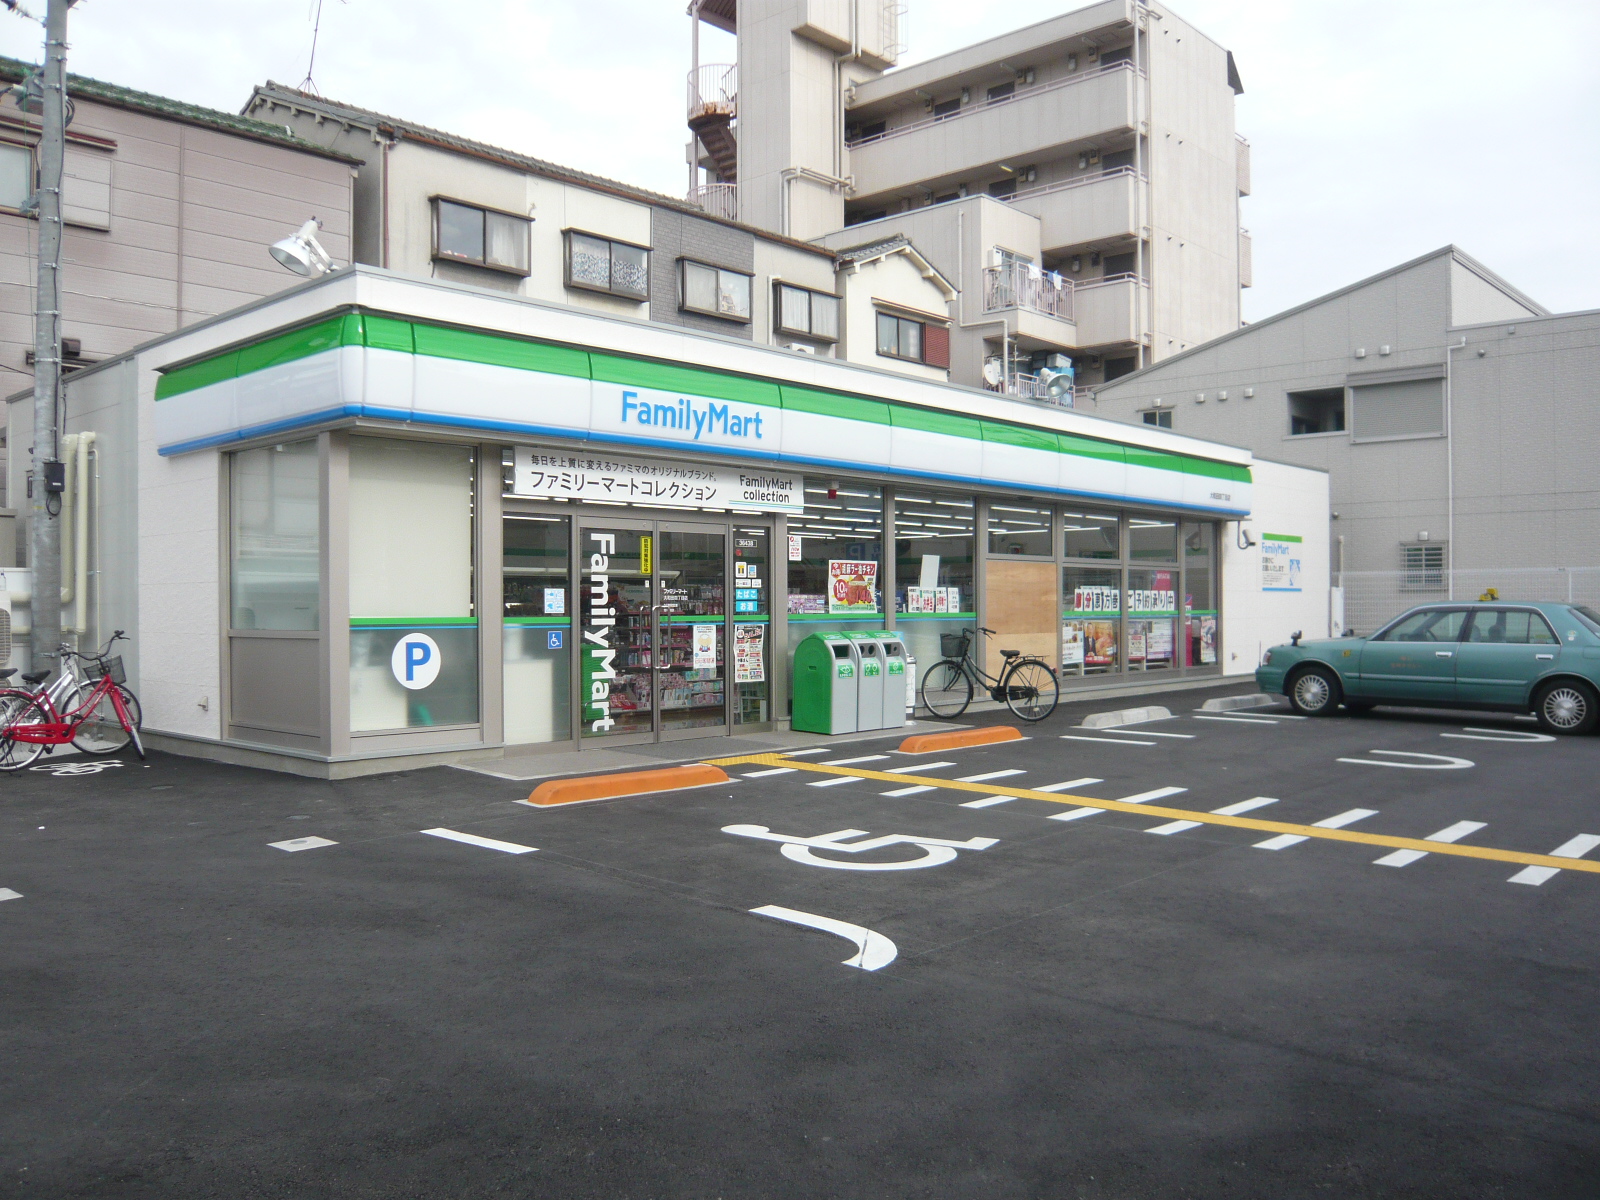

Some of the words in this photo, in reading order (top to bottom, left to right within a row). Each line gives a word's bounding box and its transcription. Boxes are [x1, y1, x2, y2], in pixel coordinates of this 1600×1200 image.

[622, 390, 763, 440] FamilyMart
[531, 454, 718, 482] 毎日を上質に変えるファミマのオリジナルブランド。
[531, 471, 717, 502] ファミリーマートコレクション
[739, 474, 793, 492] FamilyMart
[743, 489, 790, 503] collection
[1262, 541, 1289, 557] FamilyMart
[737, 590, 757, 598] たばこ
[740, 603, 754, 611] お酒
[584, 533, 616, 733] FamilyMart
[405, 642, 431, 681] P
